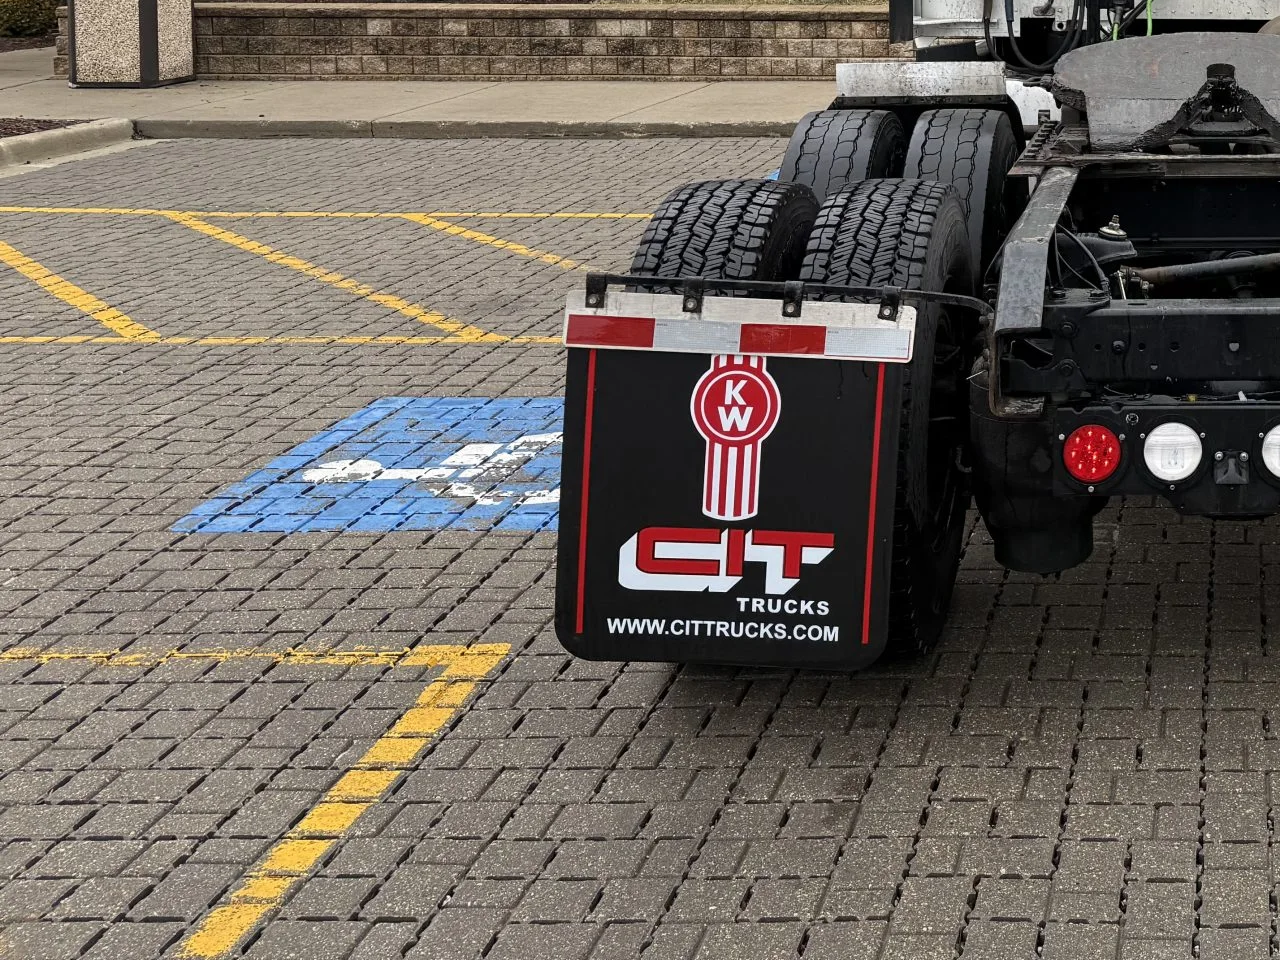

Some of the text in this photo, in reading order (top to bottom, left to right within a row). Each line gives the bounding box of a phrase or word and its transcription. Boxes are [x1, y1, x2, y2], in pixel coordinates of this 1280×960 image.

[618, 526, 835, 595] CIT
[736, 597, 830, 616] TRUCKS
[607, 617, 840, 643] WWW.CITTRUCKS.COM
